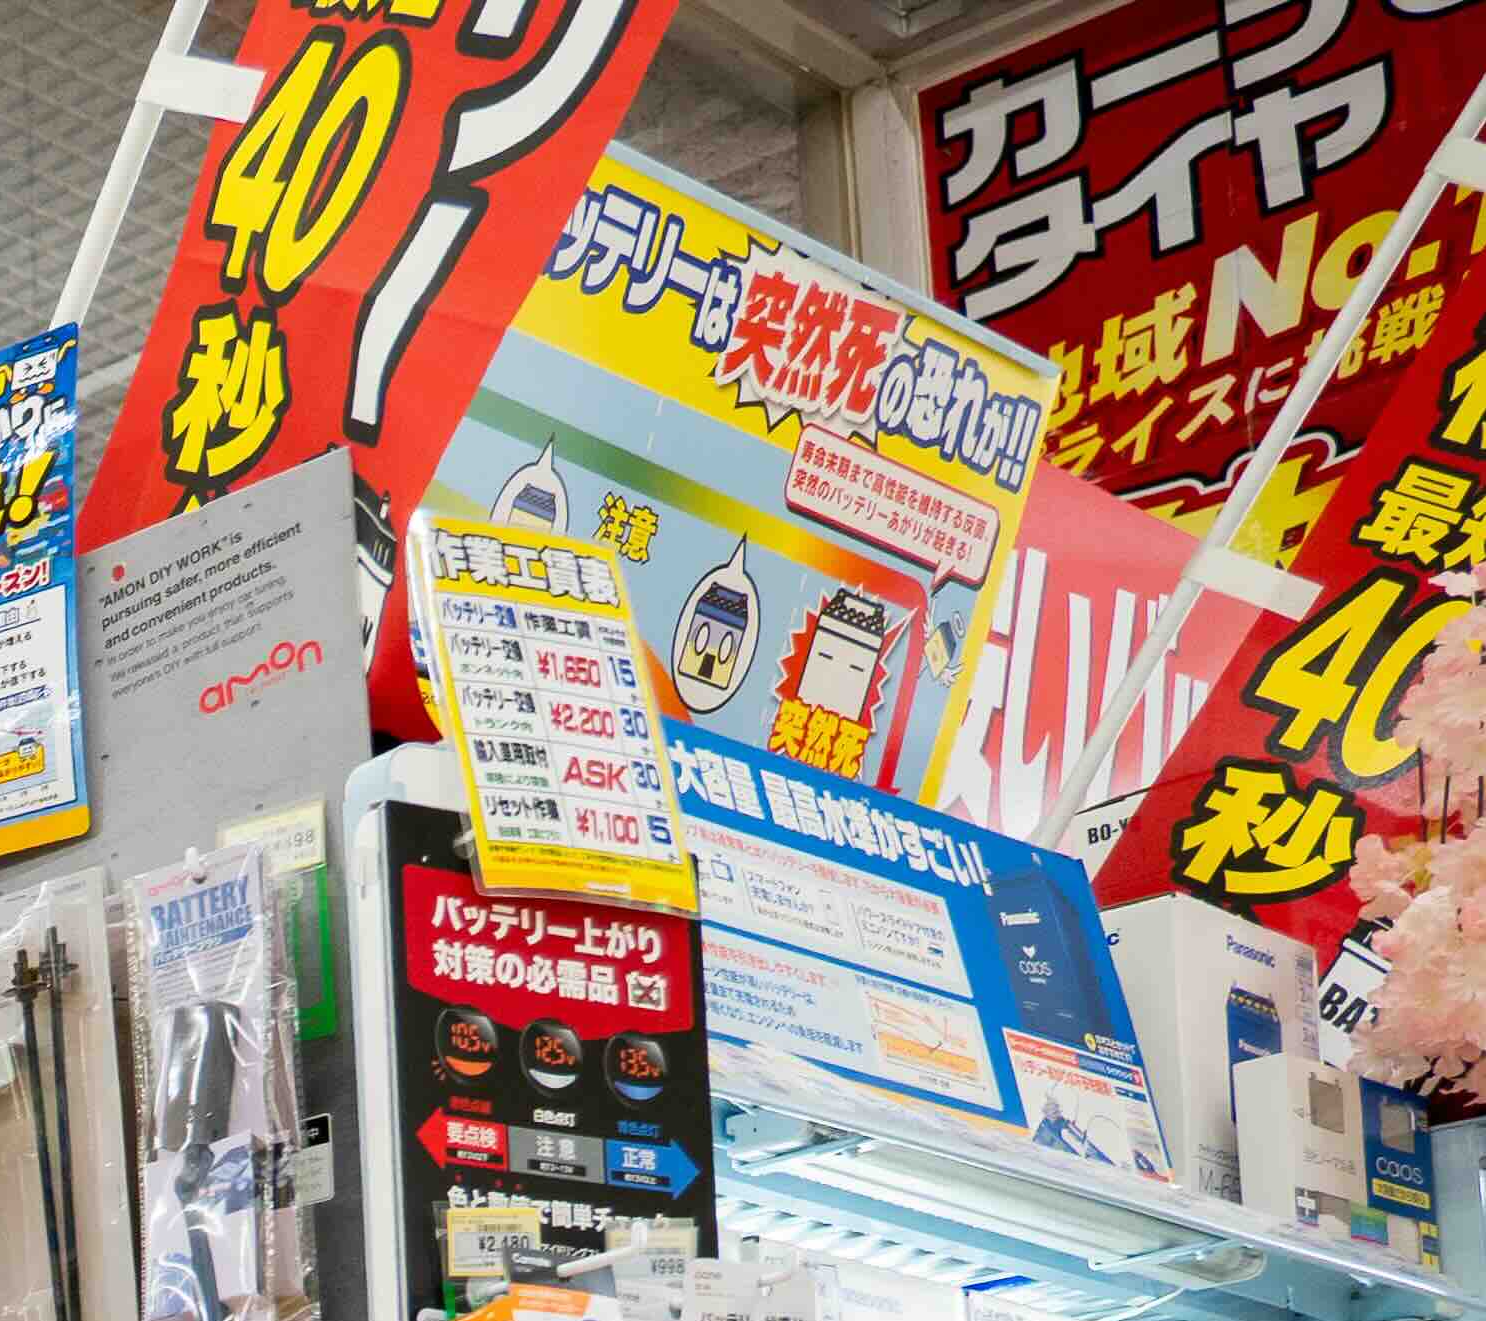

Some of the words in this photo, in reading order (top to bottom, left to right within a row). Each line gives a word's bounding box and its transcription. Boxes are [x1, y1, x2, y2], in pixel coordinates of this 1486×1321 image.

[953, 58, 1388, 322] タイヤ
[100, 591, 162, 632] pursuing
[164, 574, 203, 601] safer,
[203, 555, 241, 579] more
[242, 521, 303, 559] efficient
[103, 629, 131, 650] and
[130, 595, 208, 636] convenient
[208, 559, 278, 601] products.
[148, 563, 173, 586] DIY
[198, 639, 324, 715] amon
[760, 769, 995, 896] 最高水準がすごい!!
[431, 895, 664, 964] バッテリー上がり
[432, 940, 621, 1006] 対策の必需品
[620, 1146, 657, 1171] 正常
